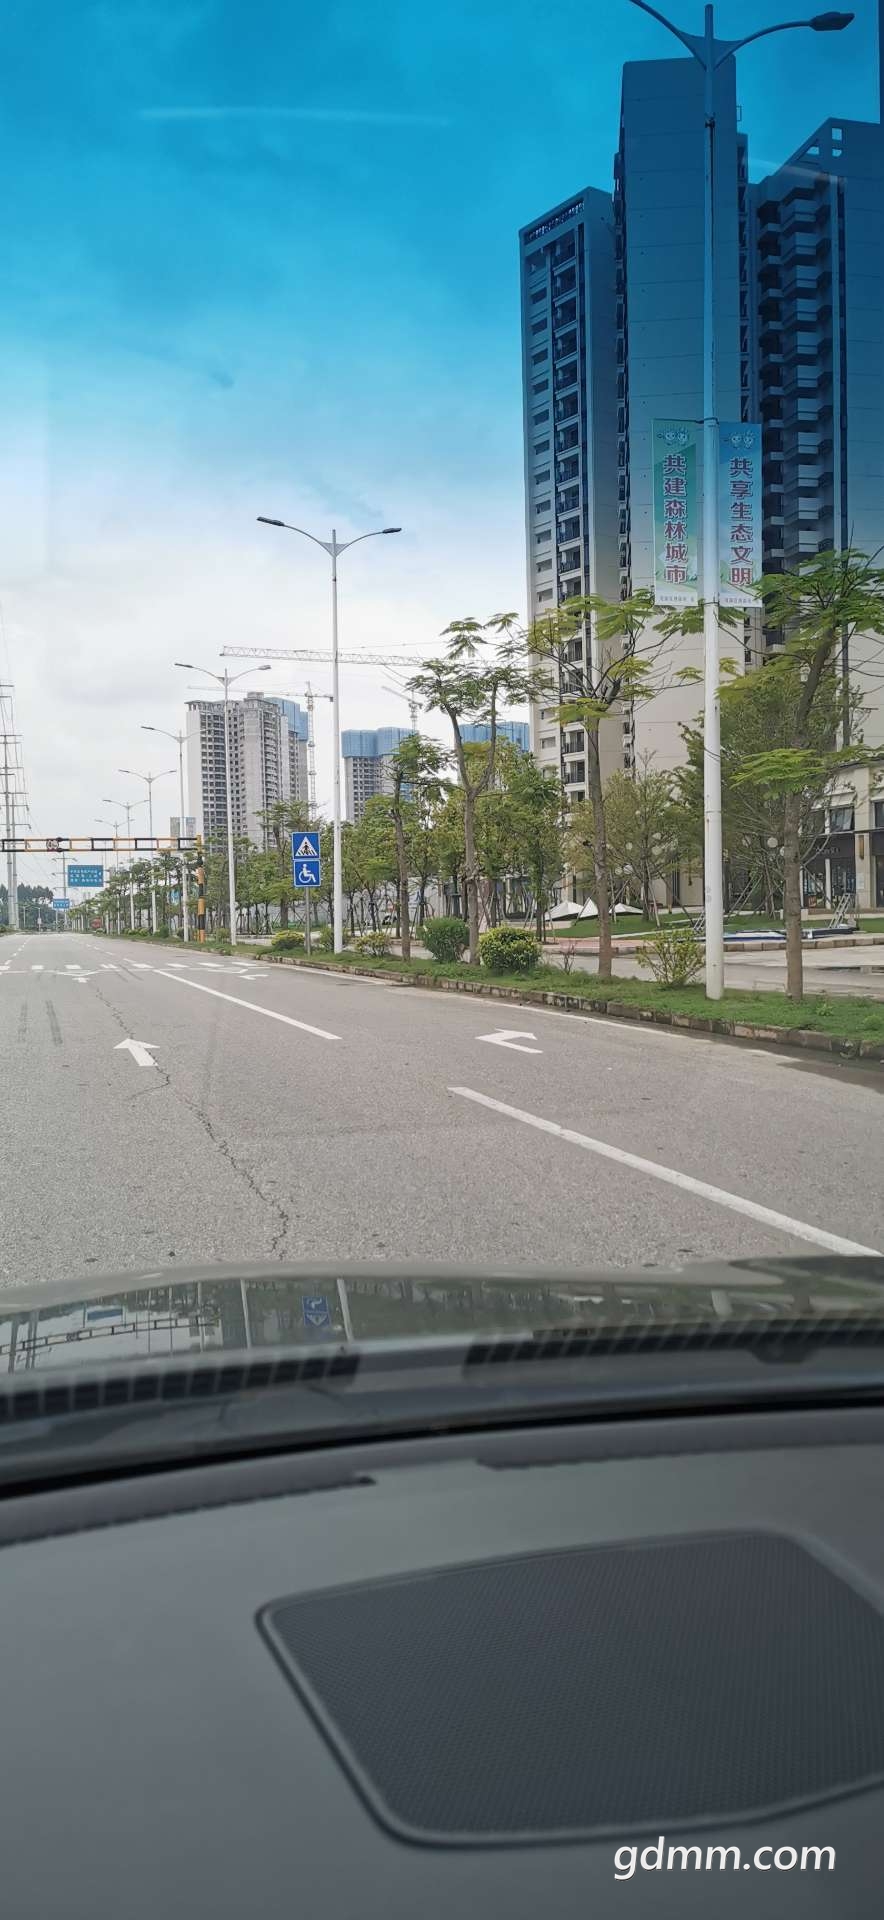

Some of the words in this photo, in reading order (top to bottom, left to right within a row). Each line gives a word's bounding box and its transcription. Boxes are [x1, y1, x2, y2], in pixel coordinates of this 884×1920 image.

[663, 454, 687, 584] 共建森林城市
[729, 458, 753, 586] 共享生态文明
